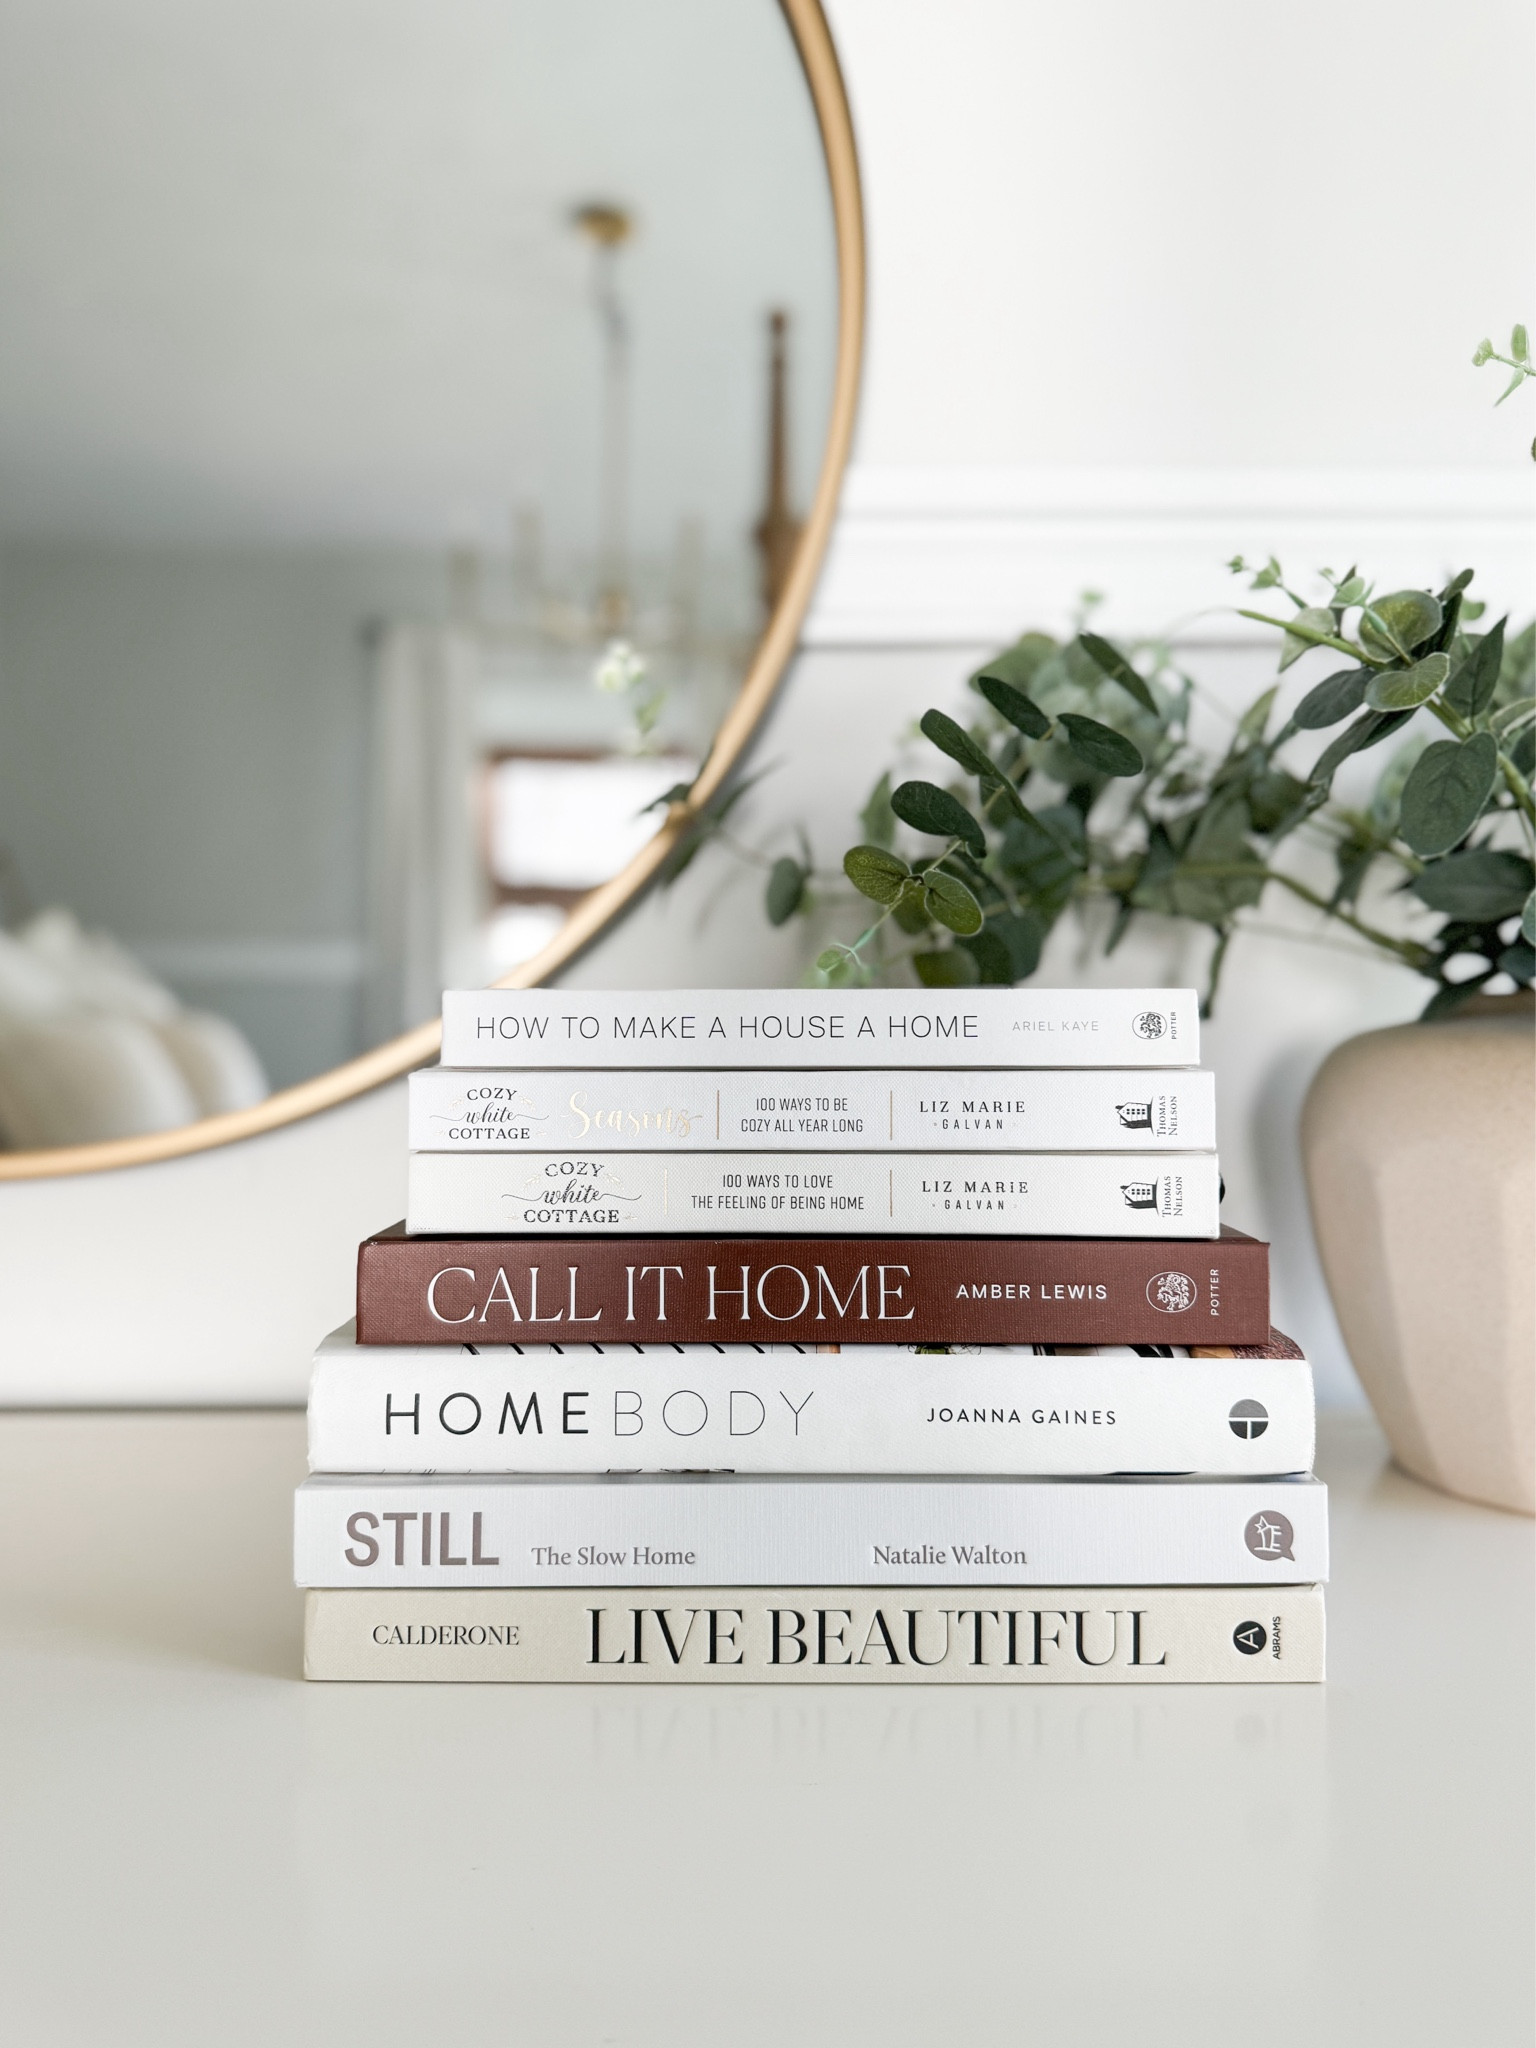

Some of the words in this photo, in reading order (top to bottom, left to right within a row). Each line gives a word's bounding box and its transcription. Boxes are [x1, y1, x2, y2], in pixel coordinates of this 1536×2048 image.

[477, 1016, 550, 1039] HOW
[562, 1016, 600, 1039] TO
[613, 1016, 696, 1039] MAKE
[708, 1016, 726, 1038] A
[739, 1015, 845, 1039] HOUSE
[857, 1015, 876, 1038] A
[889, 1015, 979, 1038] HOME
[1012, 1021, 1055, 1032] ARIEL
[1062, 1020, 1099, 1032] KAYE
[466, 1087, 518, 1101] COZY
[756, 1097, 777, 1111] 100
[779, 1097, 813, 1111] WAYS
[816, 1098, 831, 1111] TO
[833, 1098, 848, 1112] BE
[919, 1100, 950, 1113] LIZ
[962, 1100, 1026, 1113] MARIE
[563, 1090, 699, 1139] Seasons
[1156, 1096, 1166, 1137] THOMAS
[1168, 1096, 1178, 1136] NELSON
[741, 1117, 771, 1132] COZY
[774, 1117, 796, 1132] ALL
[799, 1117, 828, 1132] YEAR
[832, 1119, 864, 1133] LONG
[942, 1118, 1004, 1130] GALVAN
[448, 1127, 531, 1140] COTTAGE
[544, 1161, 605, 1178] COZY
[723, 1174, 742, 1187] 100
[747, 1174, 779, 1188] WAYS
[784, 1174, 800, 1188] TO
[804, 1175, 833, 1189] LOVE
[922, 1180, 952, 1193] LIZ
[691, 1195, 712, 1209] THE
[718, 1195, 766, 1209] FEELING
[771, 1195, 785, 1209] OF
[790, 1195, 826, 1210] BEING
[831, 1196, 865, 1210] HOME
[944, 1200, 1005, 1210] GALVAN
[1162, 1176, 1171, 1217] THOMAS
[1173, 1176, 1183, 1217] NELSON
[523, 1209, 620, 1223] COTTAGE
[427, 1266, 602, 1323] CALL
[625, 1265, 683, 1321] IT
[706, 1265, 915, 1321] HOME
[956, 1284, 1031, 1300] AMBER
[1041, 1284, 1108, 1300] LEWIS
[1210, 1268, 1220, 1316] POTTER
[927, 1407, 1021, 1424] JOANNA
[1031, 1409, 1116, 1425] GAINES
[344, 1511, 500, 1567] STILL
[531, 1546, 572, 1566] The
[577, 1546, 627, 1566] Slow
[632, 1546, 695, 1566] Home
[873, 1545, 946, 1565] Natalie
[951, 1546, 1028, 1565] Walton
[372, 1624, 520, 1646] CALDERONE
[586, 1607, 744, 1665] LIVE
[766, 1608, 1167, 1667] BEAUTIFUL
[1272, 1616, 1281, 1660] ABRAMS
